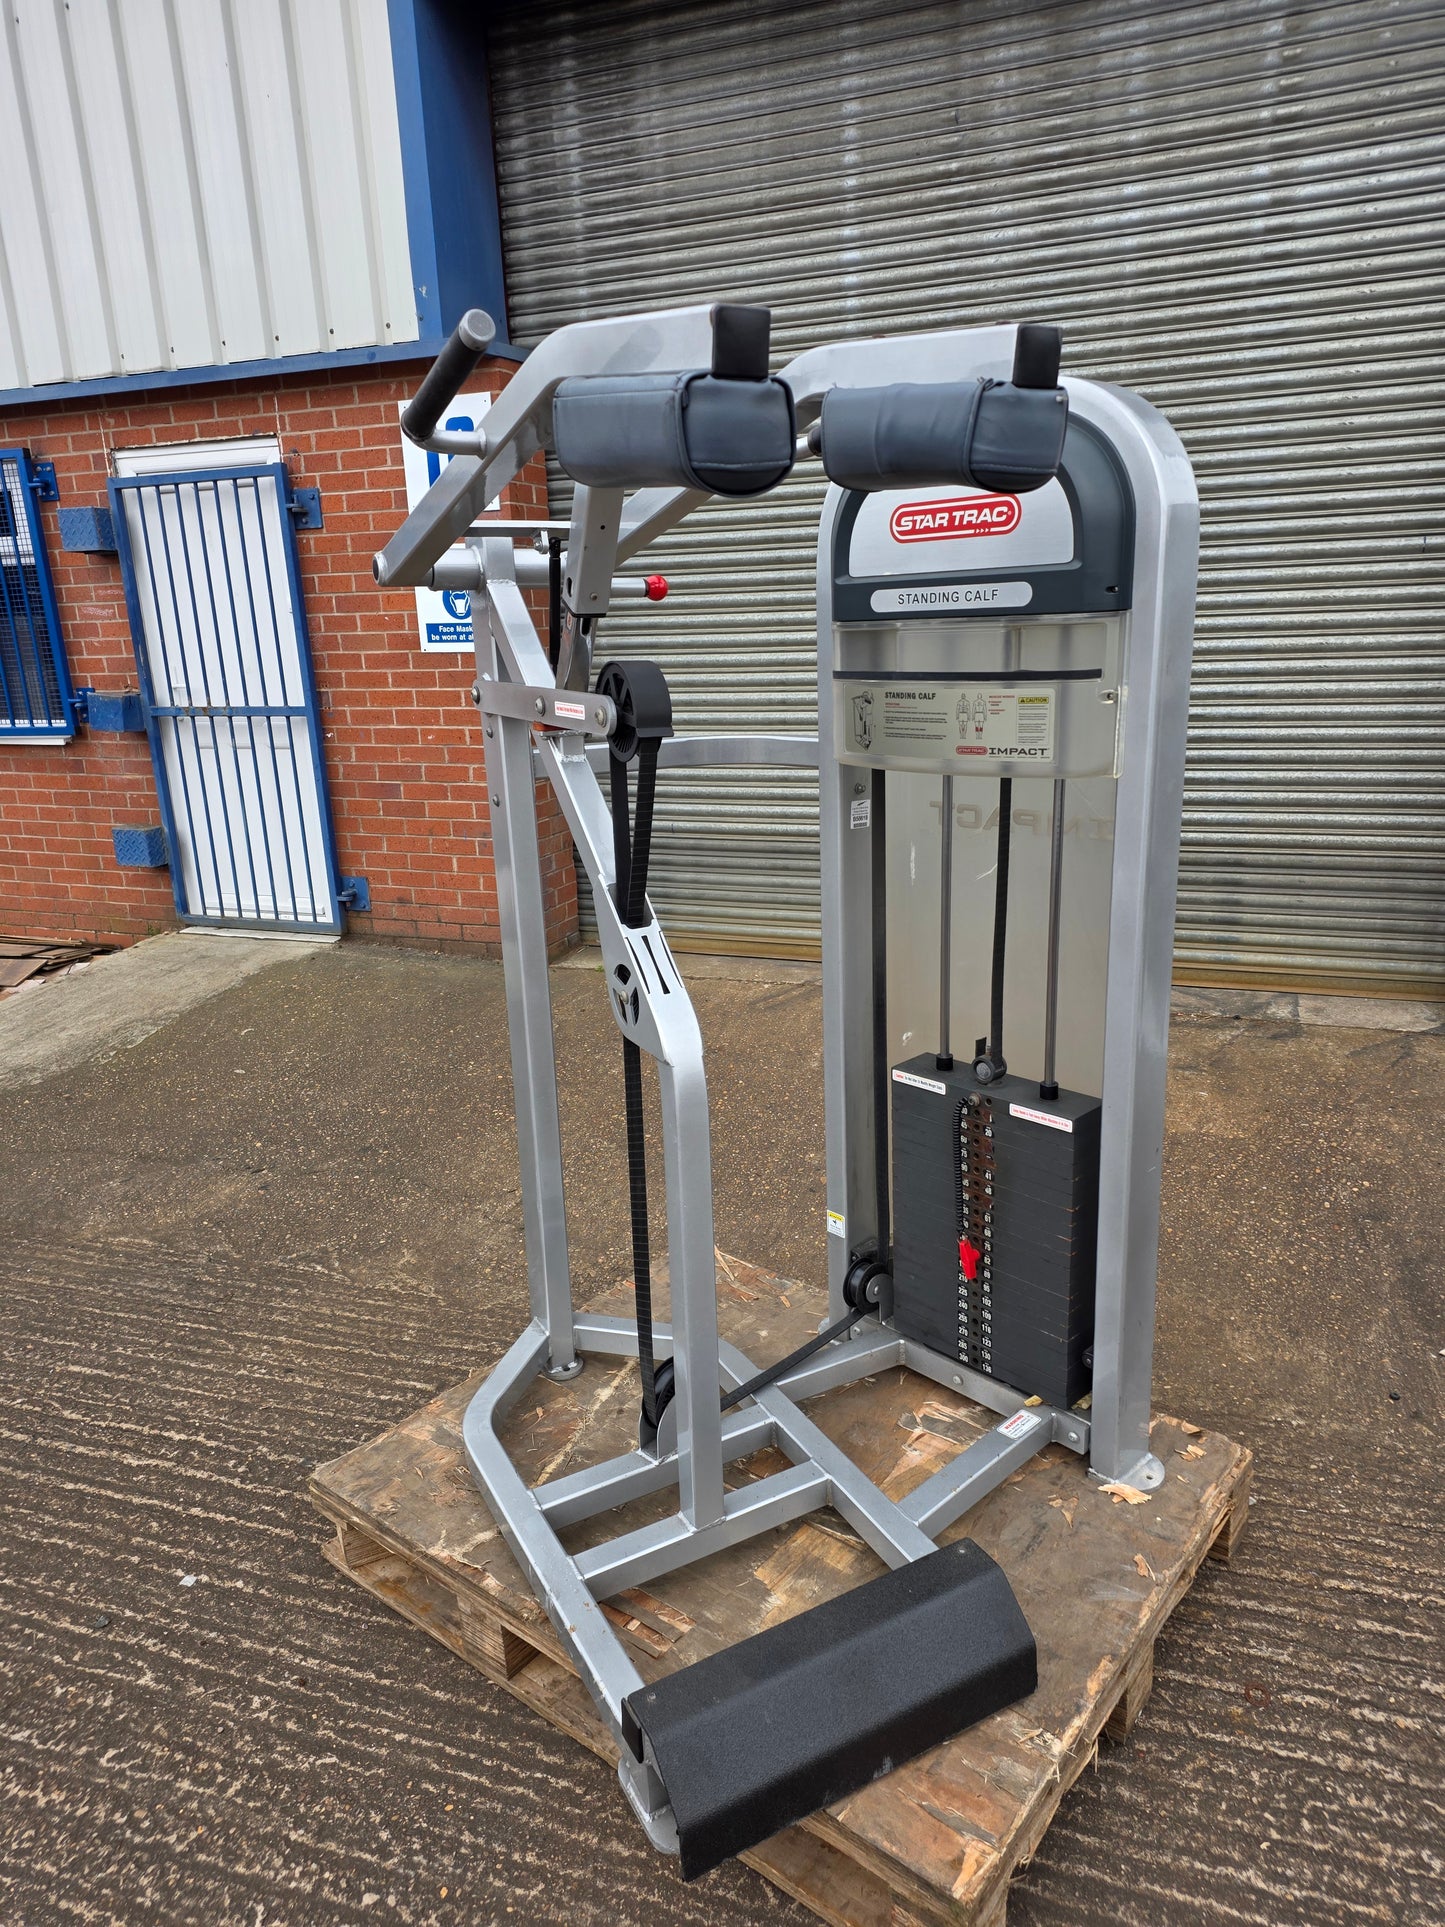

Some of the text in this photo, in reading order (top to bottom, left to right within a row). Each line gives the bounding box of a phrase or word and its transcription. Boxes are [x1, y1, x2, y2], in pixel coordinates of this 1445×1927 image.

[900, 506, 1009, 531] STAR TRAC
[898, 589, 999, 605] STANDING CALF
[918, 692, 936, 700] CALF
[989, 747, 1048, 756] IMPACT
